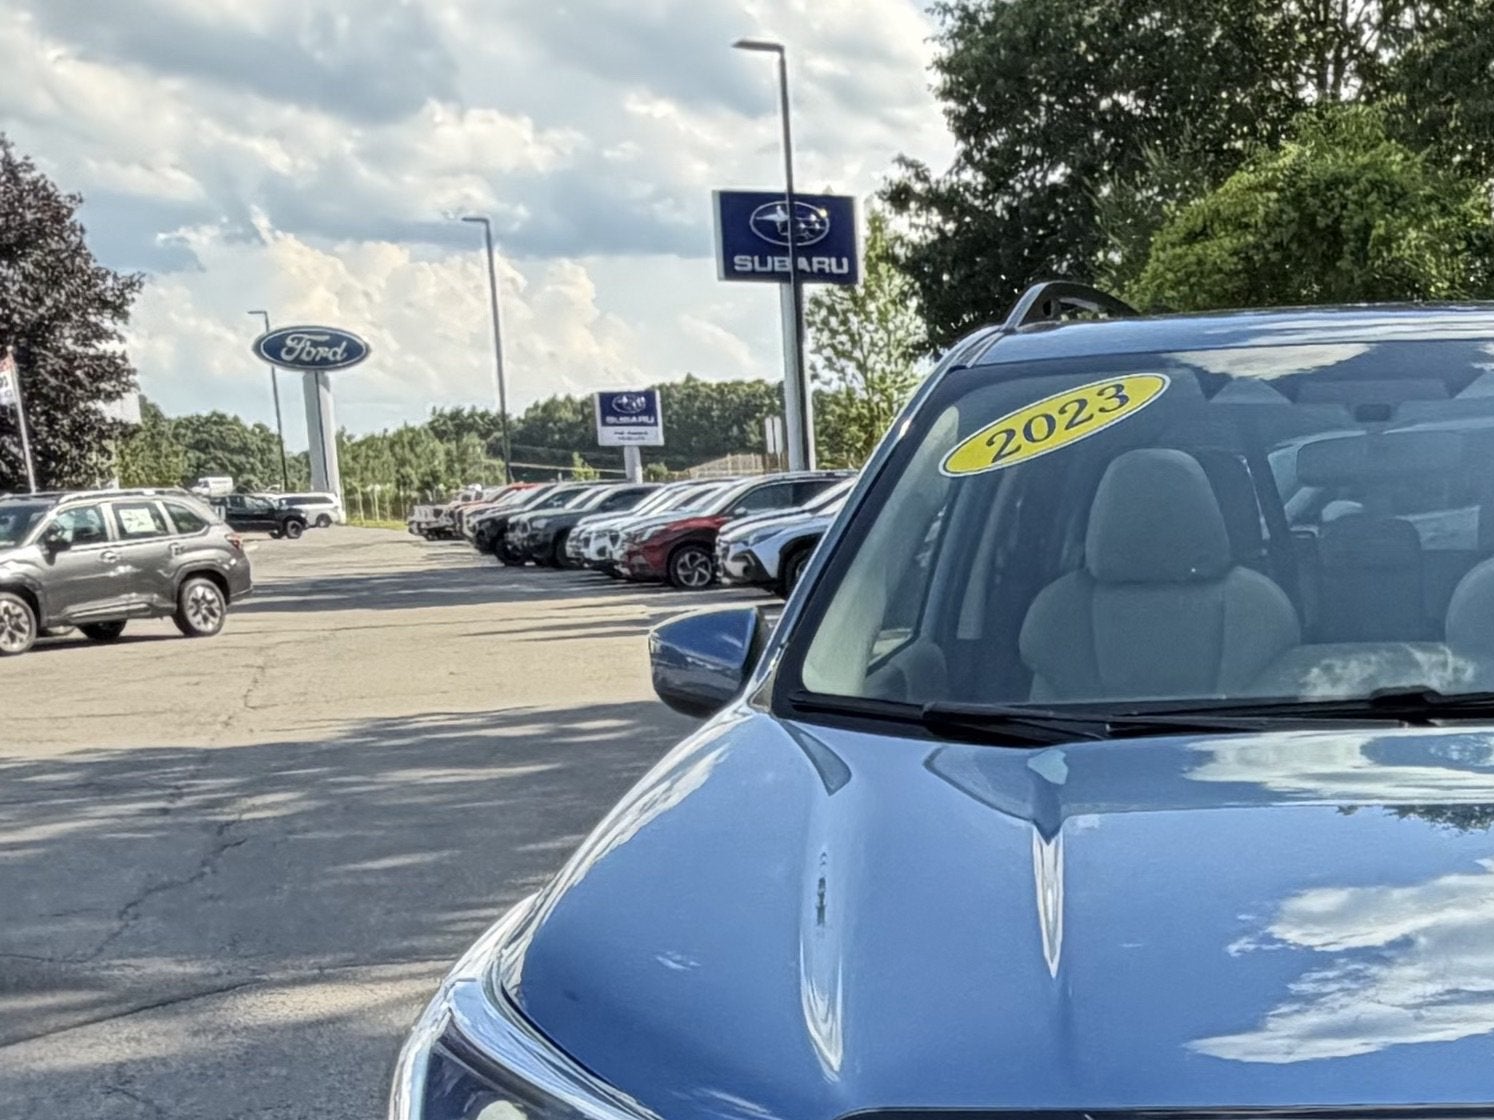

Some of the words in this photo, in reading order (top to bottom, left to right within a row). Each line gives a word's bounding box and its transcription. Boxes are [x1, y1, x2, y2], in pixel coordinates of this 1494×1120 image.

[733, 255, 849, 274] SUBARU
[281, 333, 347, 361] Ford
[986, 383, 1130, 463] 2023
